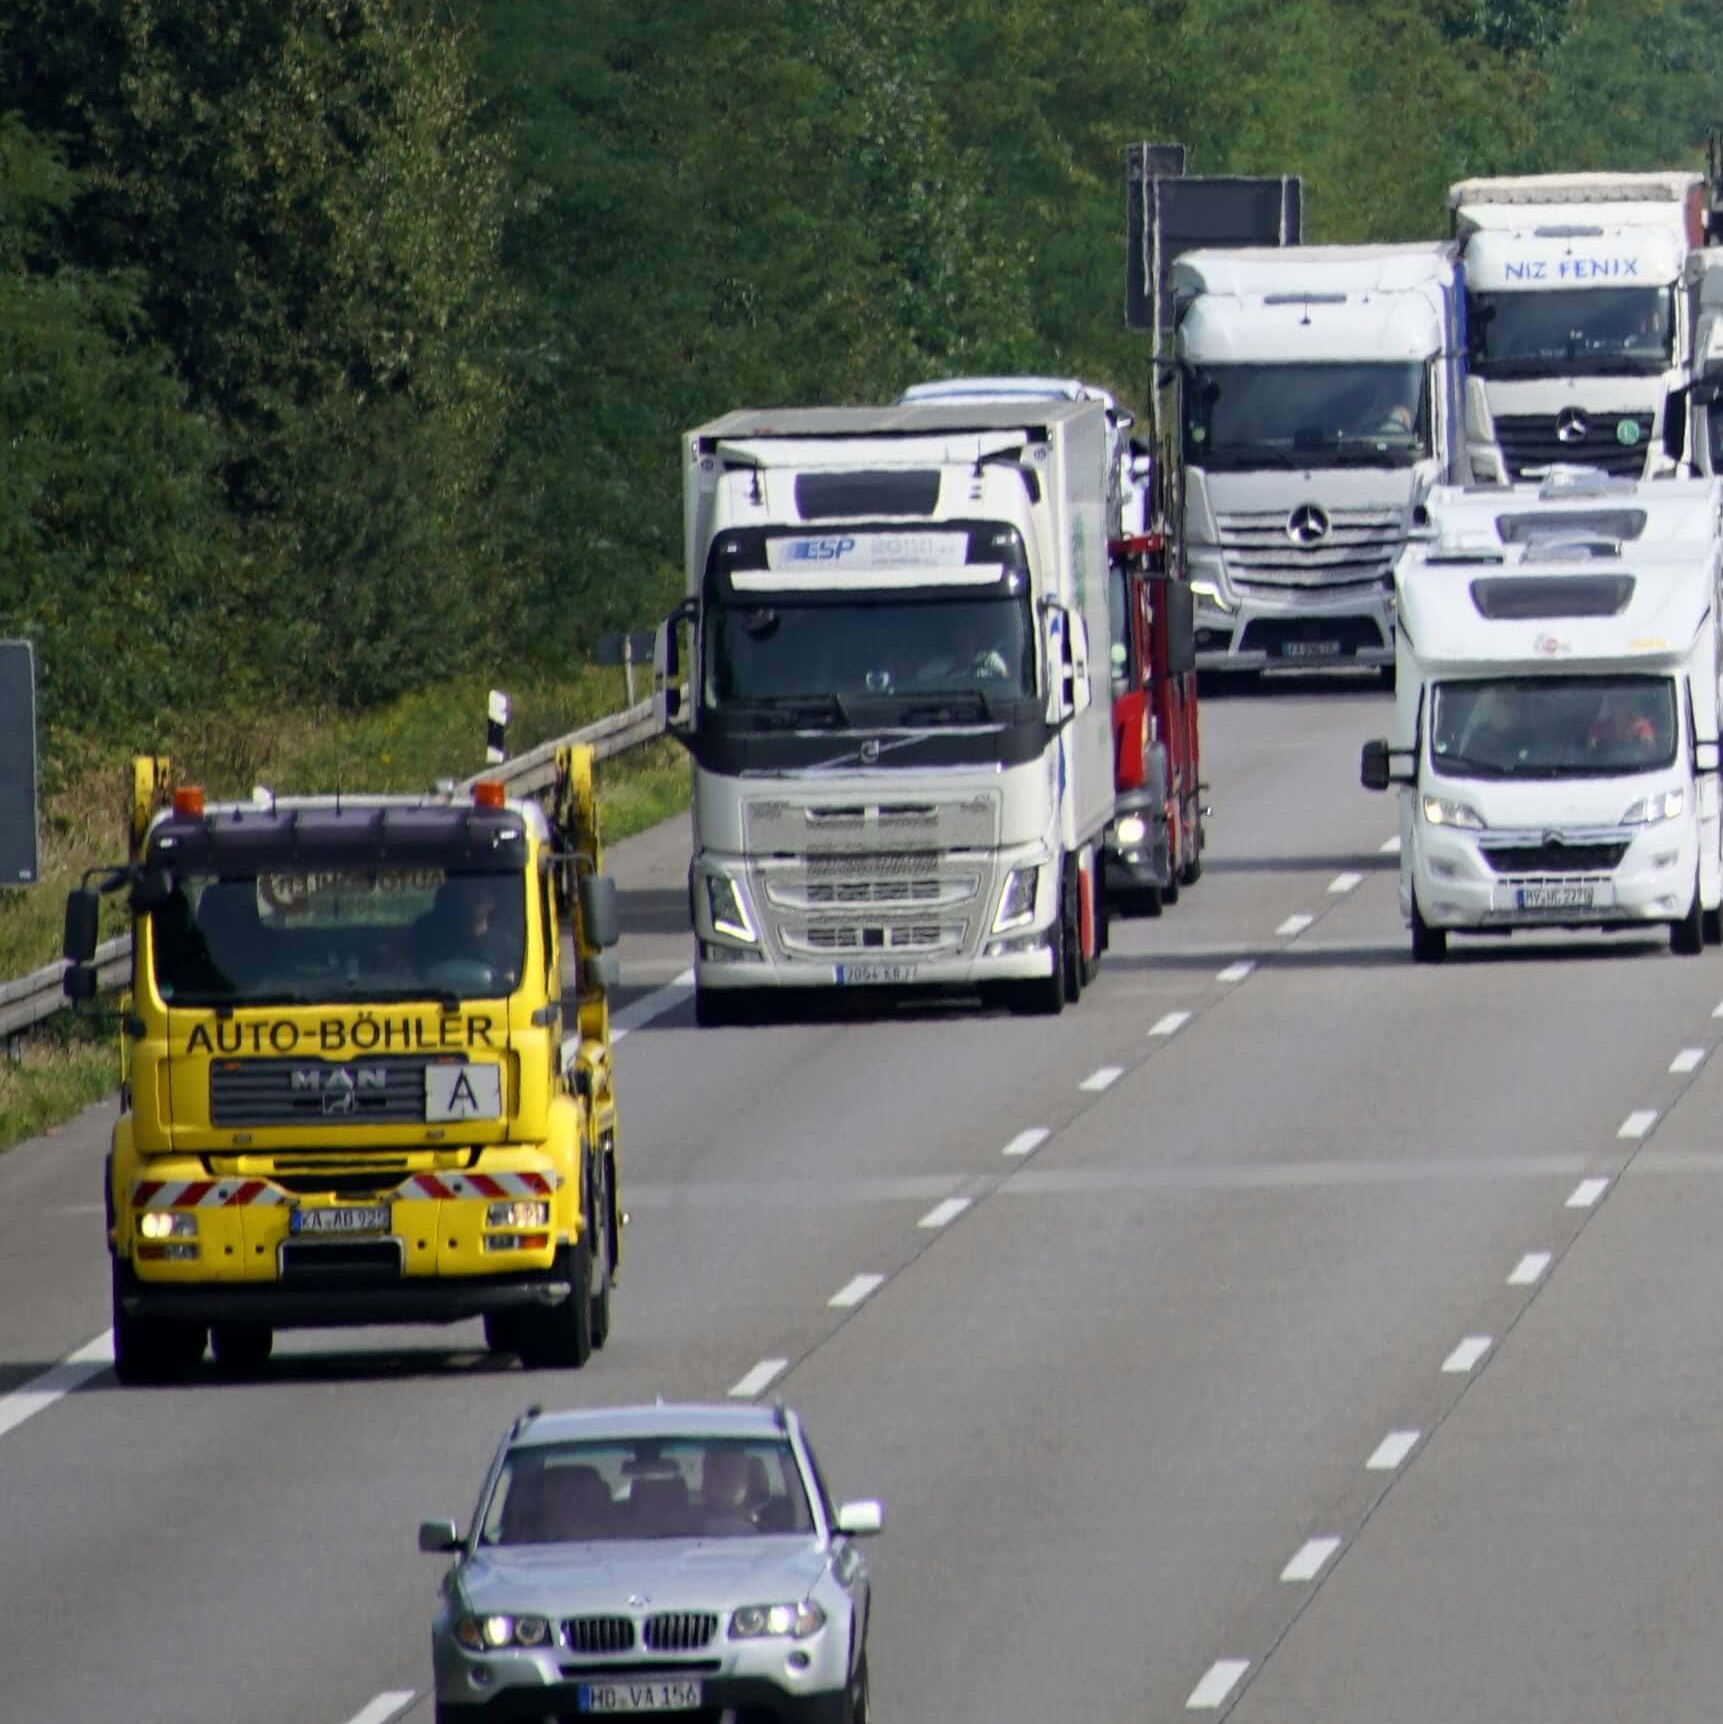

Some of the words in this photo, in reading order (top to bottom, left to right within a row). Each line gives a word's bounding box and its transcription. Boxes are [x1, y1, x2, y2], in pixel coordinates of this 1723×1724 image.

[1505, 261, 1546, 282] NIZ
[1558, 258, 1639, 279] FENIX
[806, 534, 855, 559] ESP
[186, 1011, 494, 1054] AUTO-BÖHLER
[290, 1068, 386, 1091] MAN
[448, 1067, 479, 1113] A
[630, 1685, 655, 1707] VA
